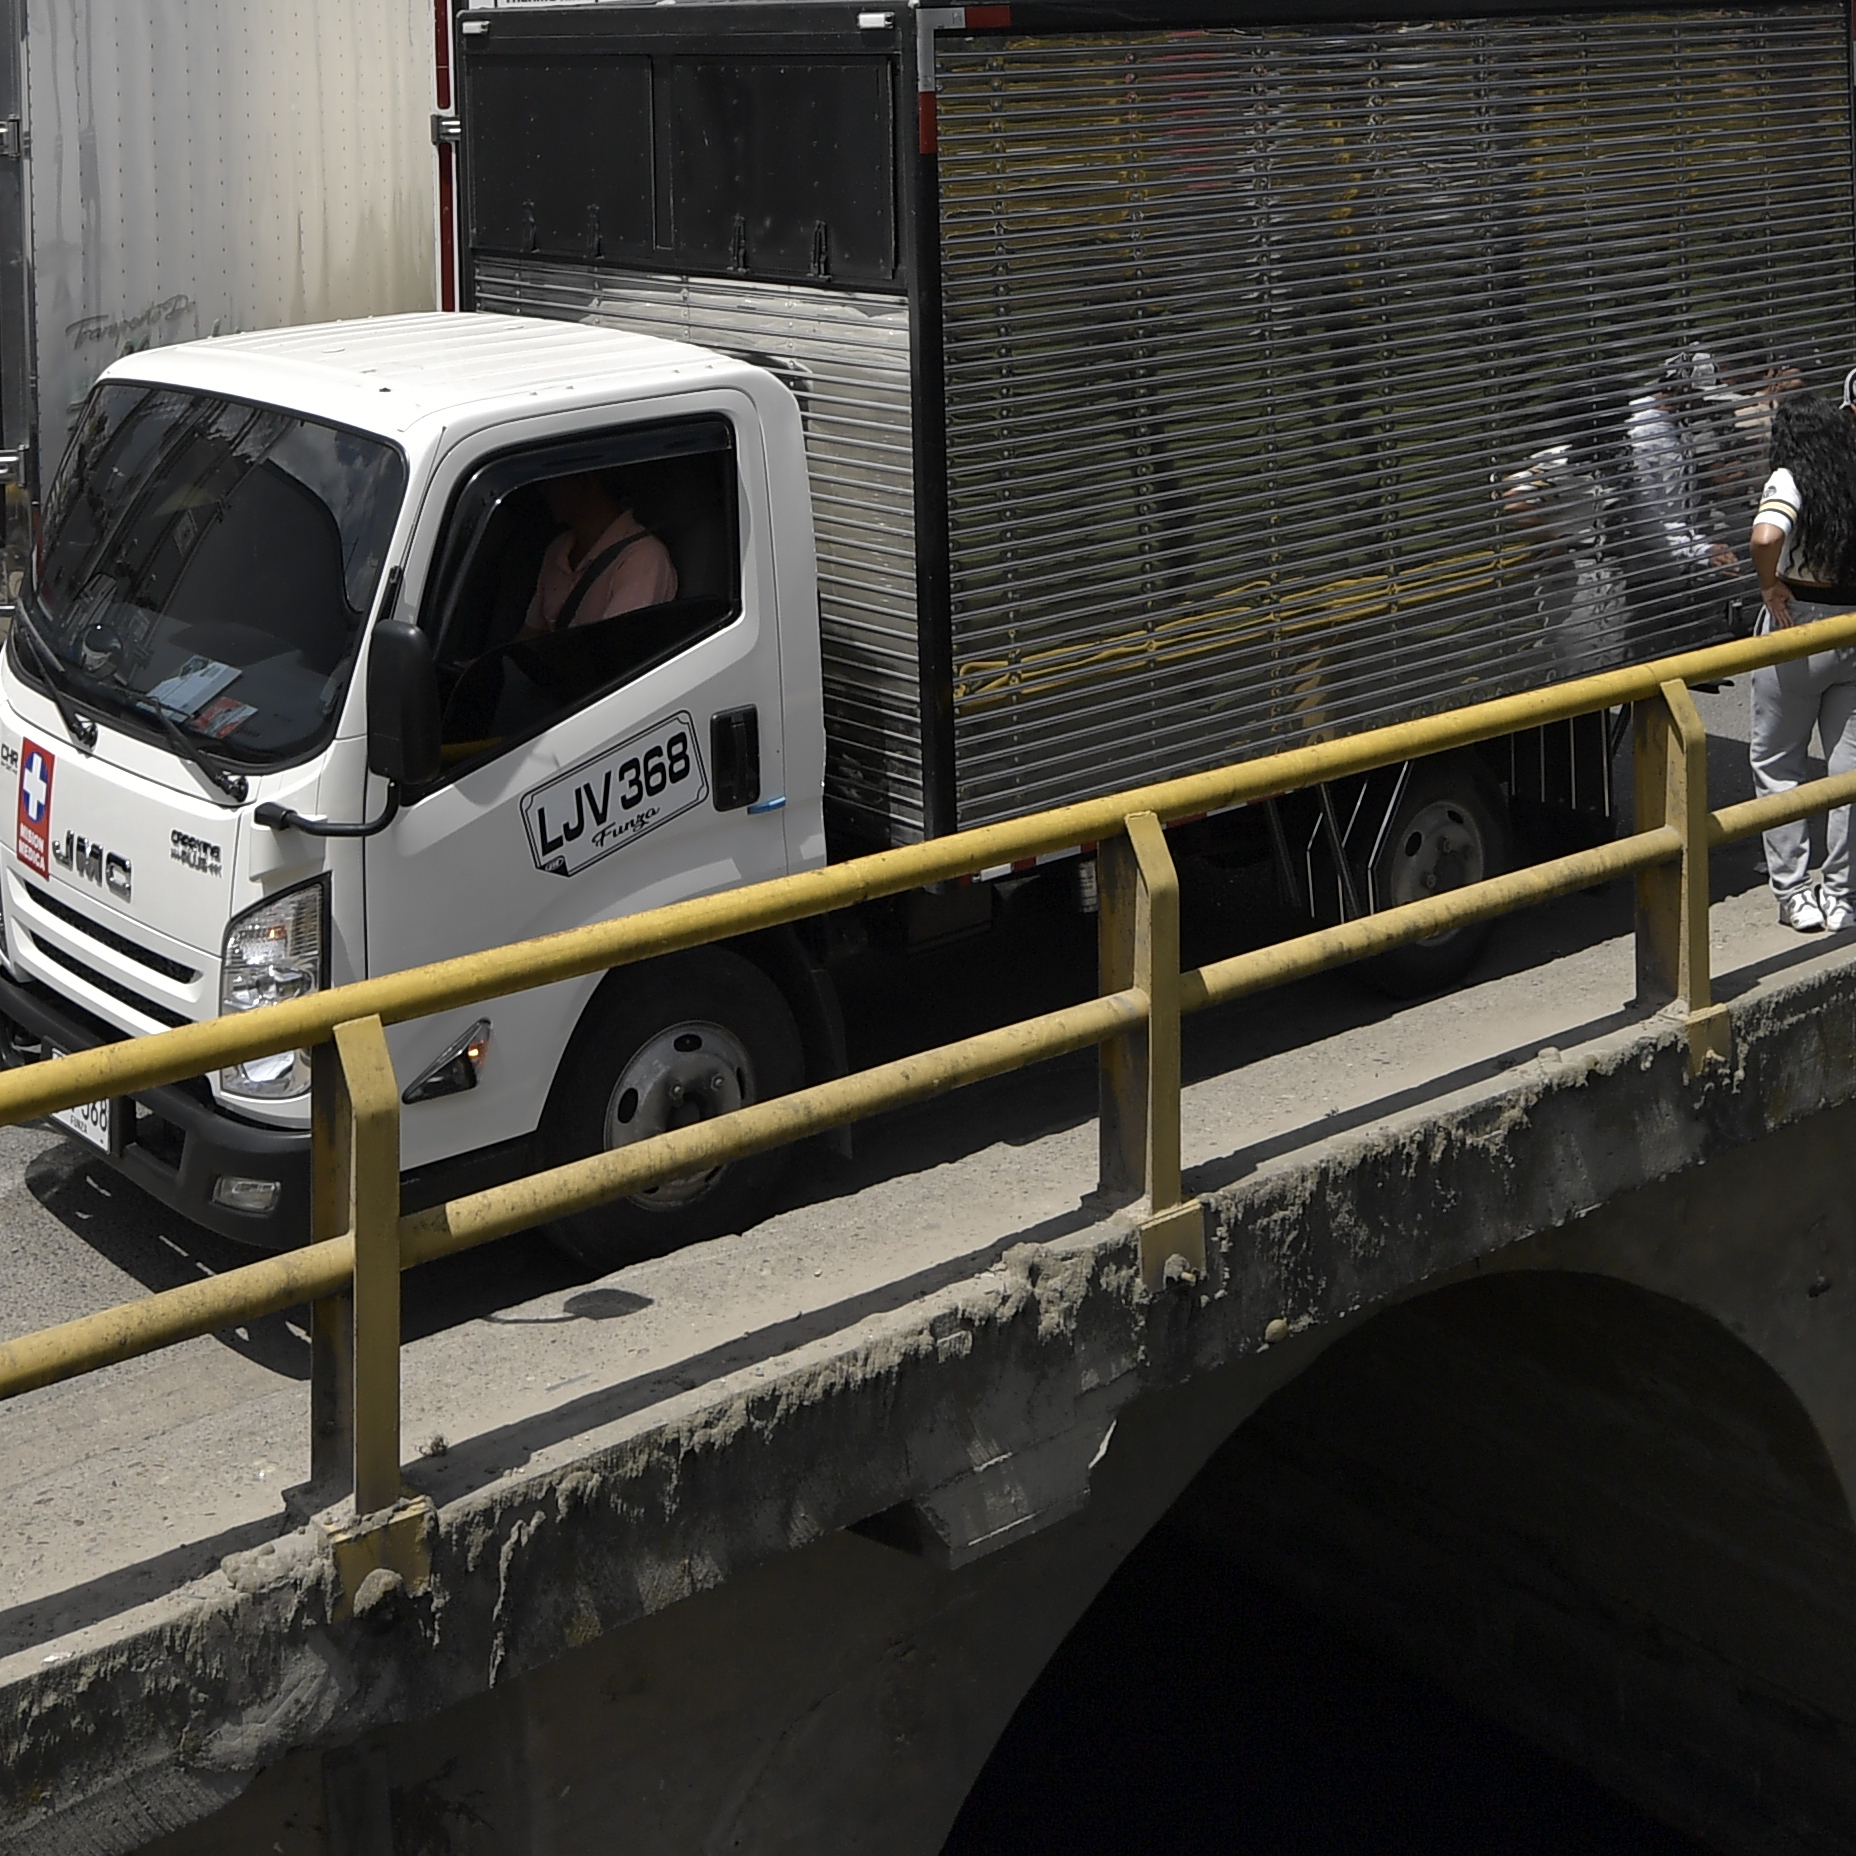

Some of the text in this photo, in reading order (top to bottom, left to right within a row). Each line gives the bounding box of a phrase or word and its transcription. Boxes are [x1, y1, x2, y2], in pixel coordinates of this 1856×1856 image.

[538, 732, 690, 856] LJV 368
[19, 838, 46, 871] MEDICA
[591, 807, 660, 847] Funza
[53, 830, 131, 903] JMC
